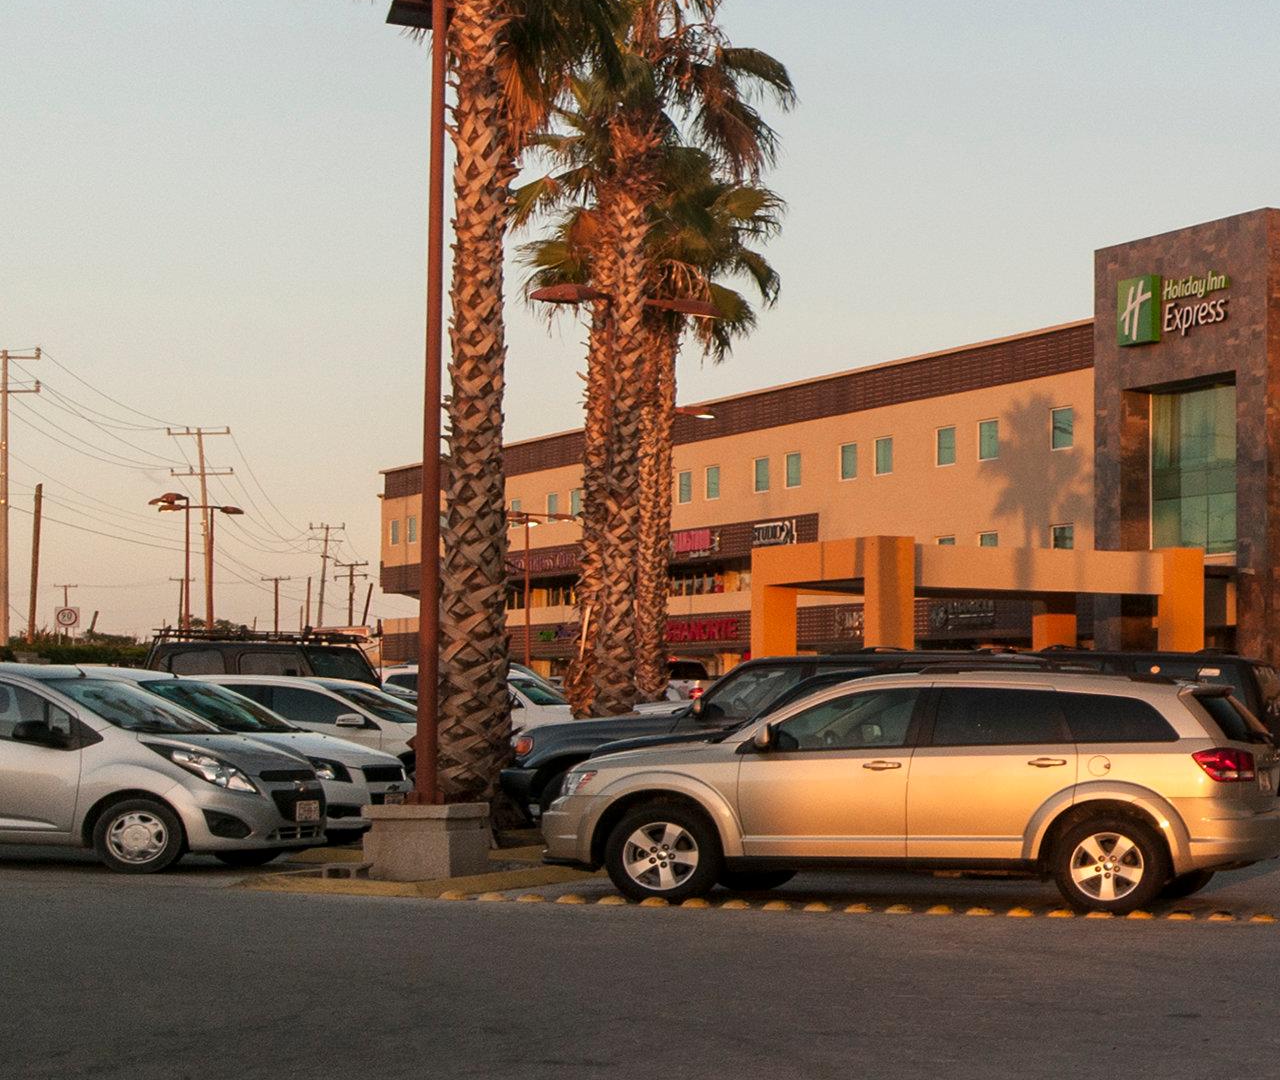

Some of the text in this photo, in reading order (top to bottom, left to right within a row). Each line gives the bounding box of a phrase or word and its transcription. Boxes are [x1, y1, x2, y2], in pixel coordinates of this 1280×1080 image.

[1163, 270, 1226, 301] Holiday Inn
[1163, 298, 1226, 336] Express
